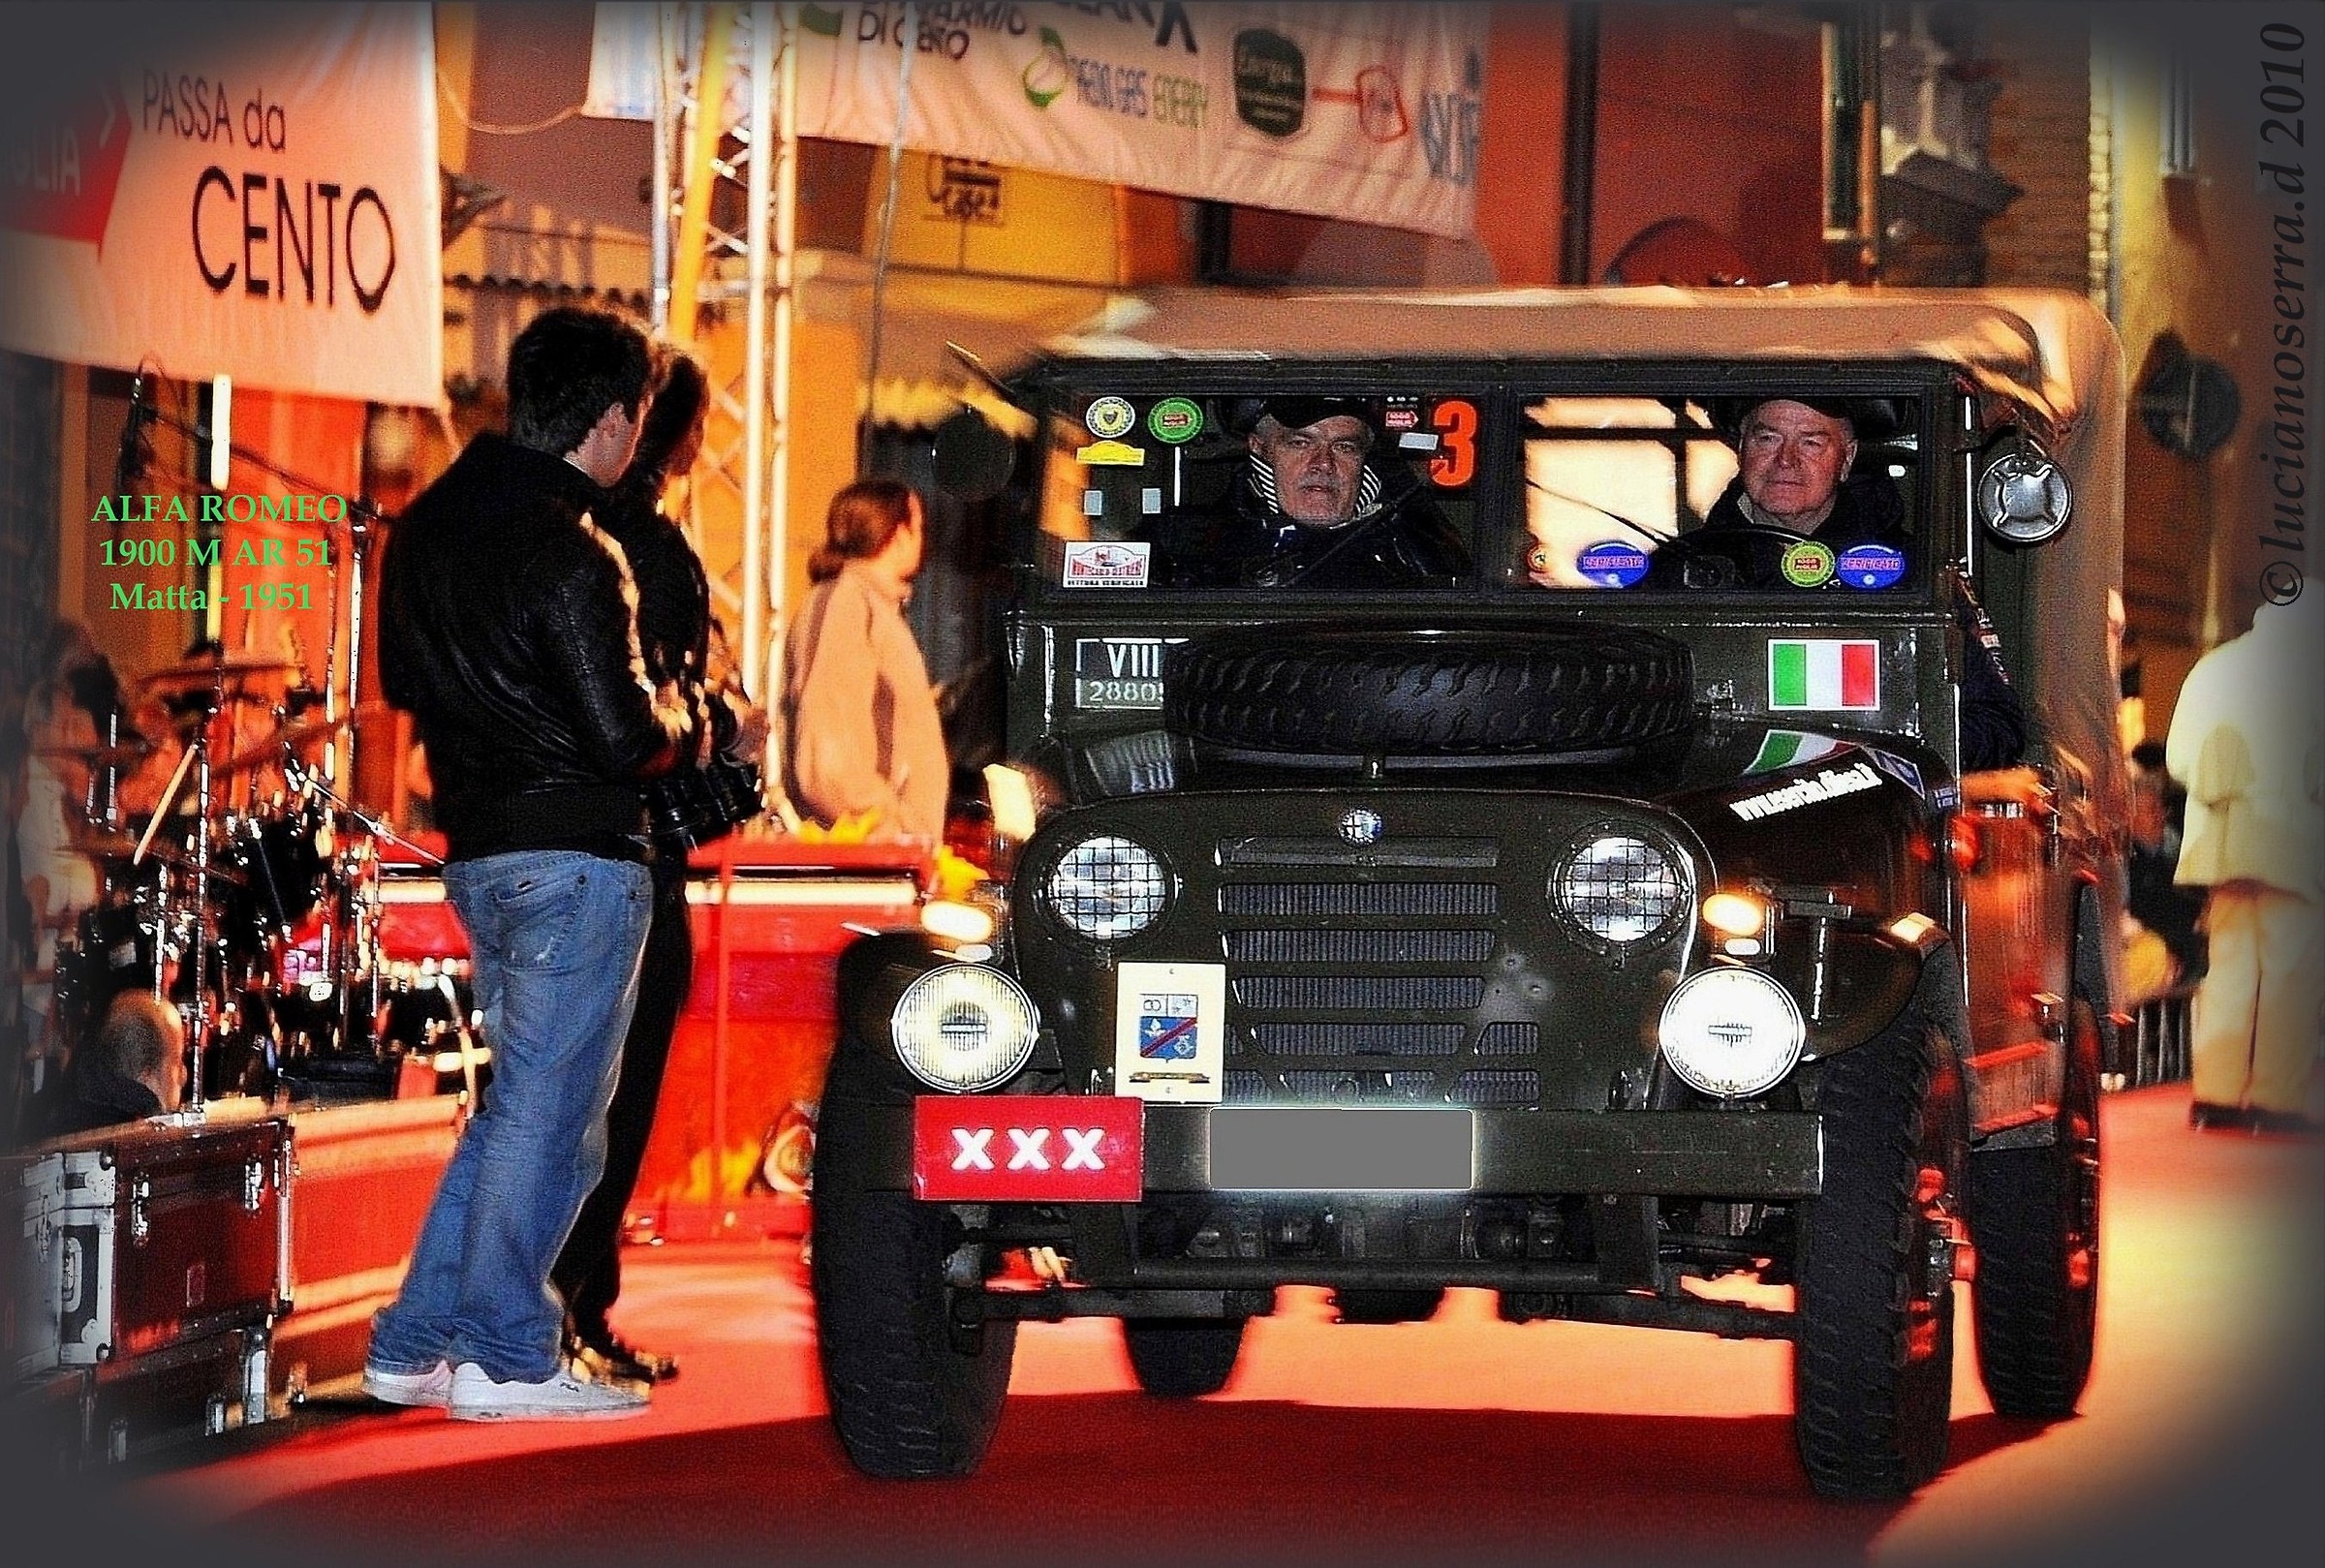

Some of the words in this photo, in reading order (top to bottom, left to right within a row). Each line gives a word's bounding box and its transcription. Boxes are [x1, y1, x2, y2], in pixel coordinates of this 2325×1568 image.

[141, 69, 234, 146] PASSA
[242, 88, 288, 152] da
[192, 165, 396, 314] CENTO
[1431, 400, 1477, 486] 3
[1106, 644, 1160, 678] VIII
